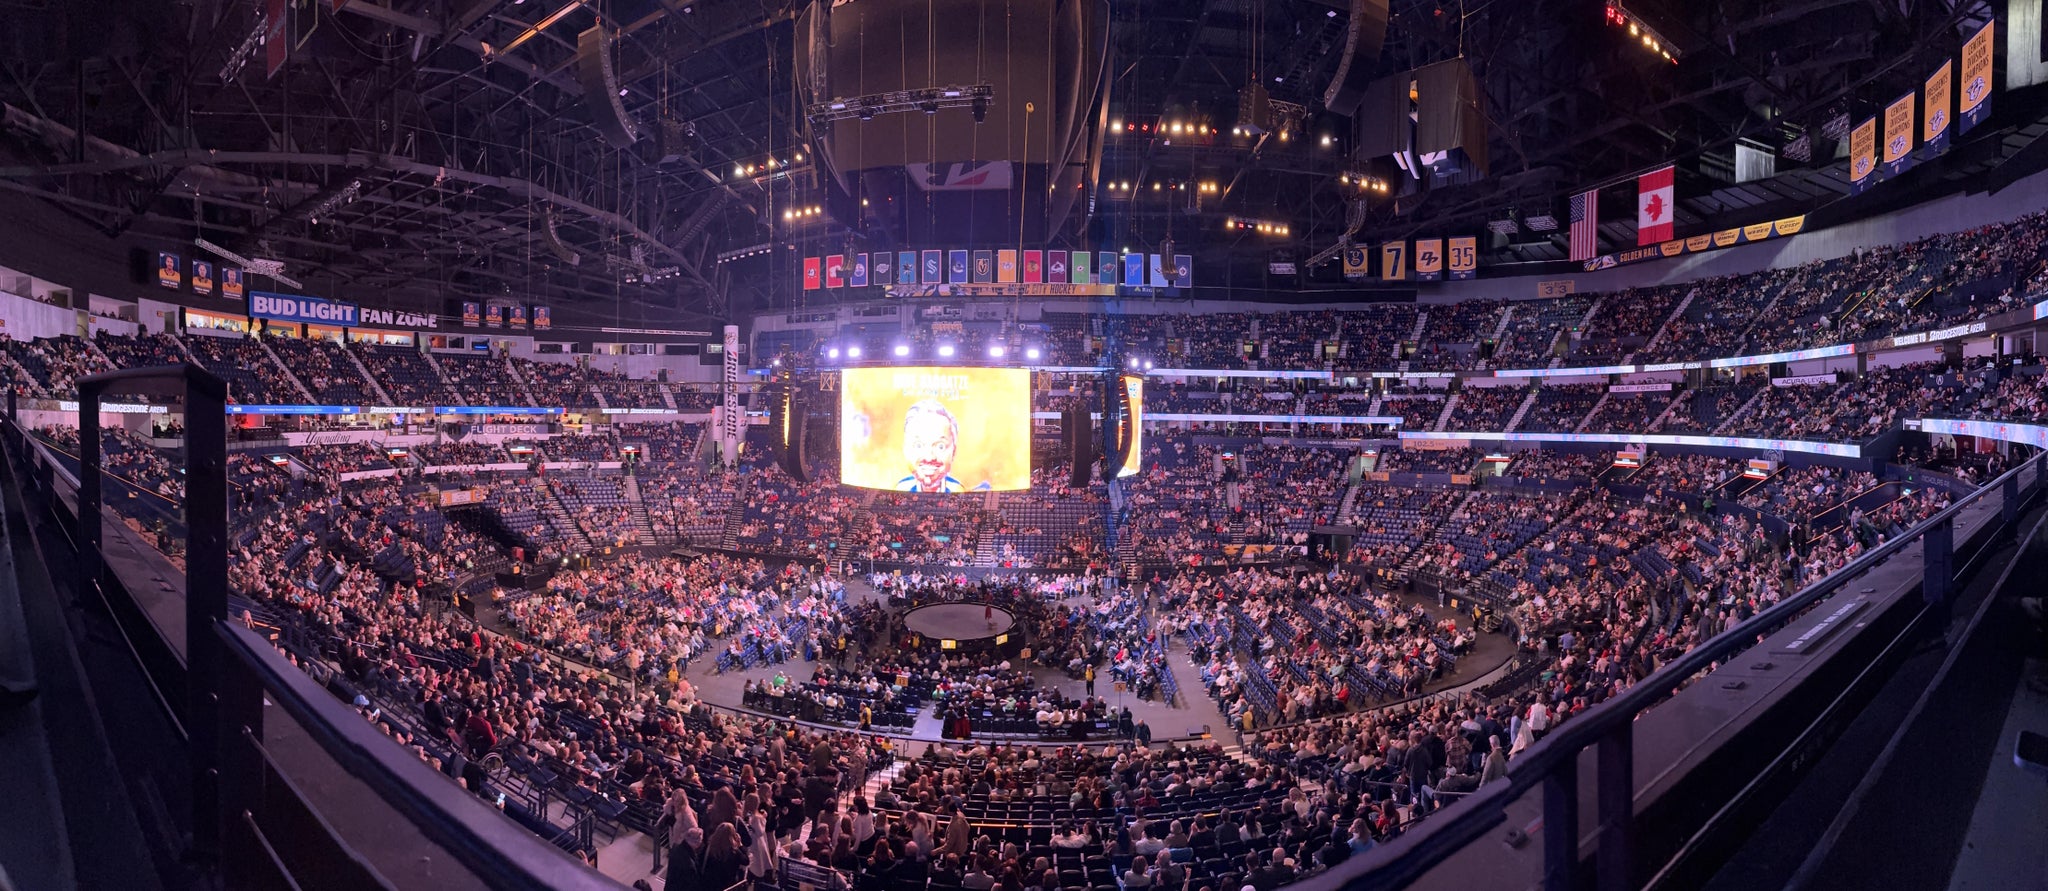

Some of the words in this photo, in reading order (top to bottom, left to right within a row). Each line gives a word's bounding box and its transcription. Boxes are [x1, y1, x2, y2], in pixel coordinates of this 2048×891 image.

[1968, 32, 1986, 55] CENTRAL
[1967, 45, 1986, 69] DIVISION
[1964, 55, 1989, 83] CHAMPIONS
[1931, 89, 1944, 107] TROPHY
[1891, 101, 1908, 117] CENTRAL
[1890, 110, 1908, 128] DIVISION
[1856, 124, 1870, 139] WESTERN
[1887, 121, 1910, 139] CHAMPIONS
[1853, 142, 1872, 160] CHAMPIONS
[1386, 247, 1402, 278] 7
[1452, 247, 1473, 267] 35
[1620, 250, 1642, 262] GOLDEN
[1643, 247, 1658, 258] HALL
[1032, 283, 1046, 295] CITY
[1050, 283, 1075, 295] HOCKEY
[253, 295, 297, 316] BUD
[300, 300, 355, 322] LIGHT
[360, 307, 393, 325] FAN
[395, 310, 438, 329] ZONE
[1893, 334, 1918, 346] WELCOME
[1919, 333, 1926, 343] TO
[1929, 325, 1969, 342] BRIDGESTONE
[1970, 321, 1986, 334] ARENA
[1644, 363, 1684, 372] BRIDGESTONE
[726, 350, 737, 440] BRIDGESTONE
[60, 400, 80, 411] WELC
[100, 402, 149, 413] BRIDGESTONE
[370, 406, 409, 414] BRIDGESTONE
[304, 431, 351, 444] Yuengling
[471, 425, 507, 434] FLIGHT
[510, 425, 537, 434] DECK
[1785, 640, 1803, 649] NO
